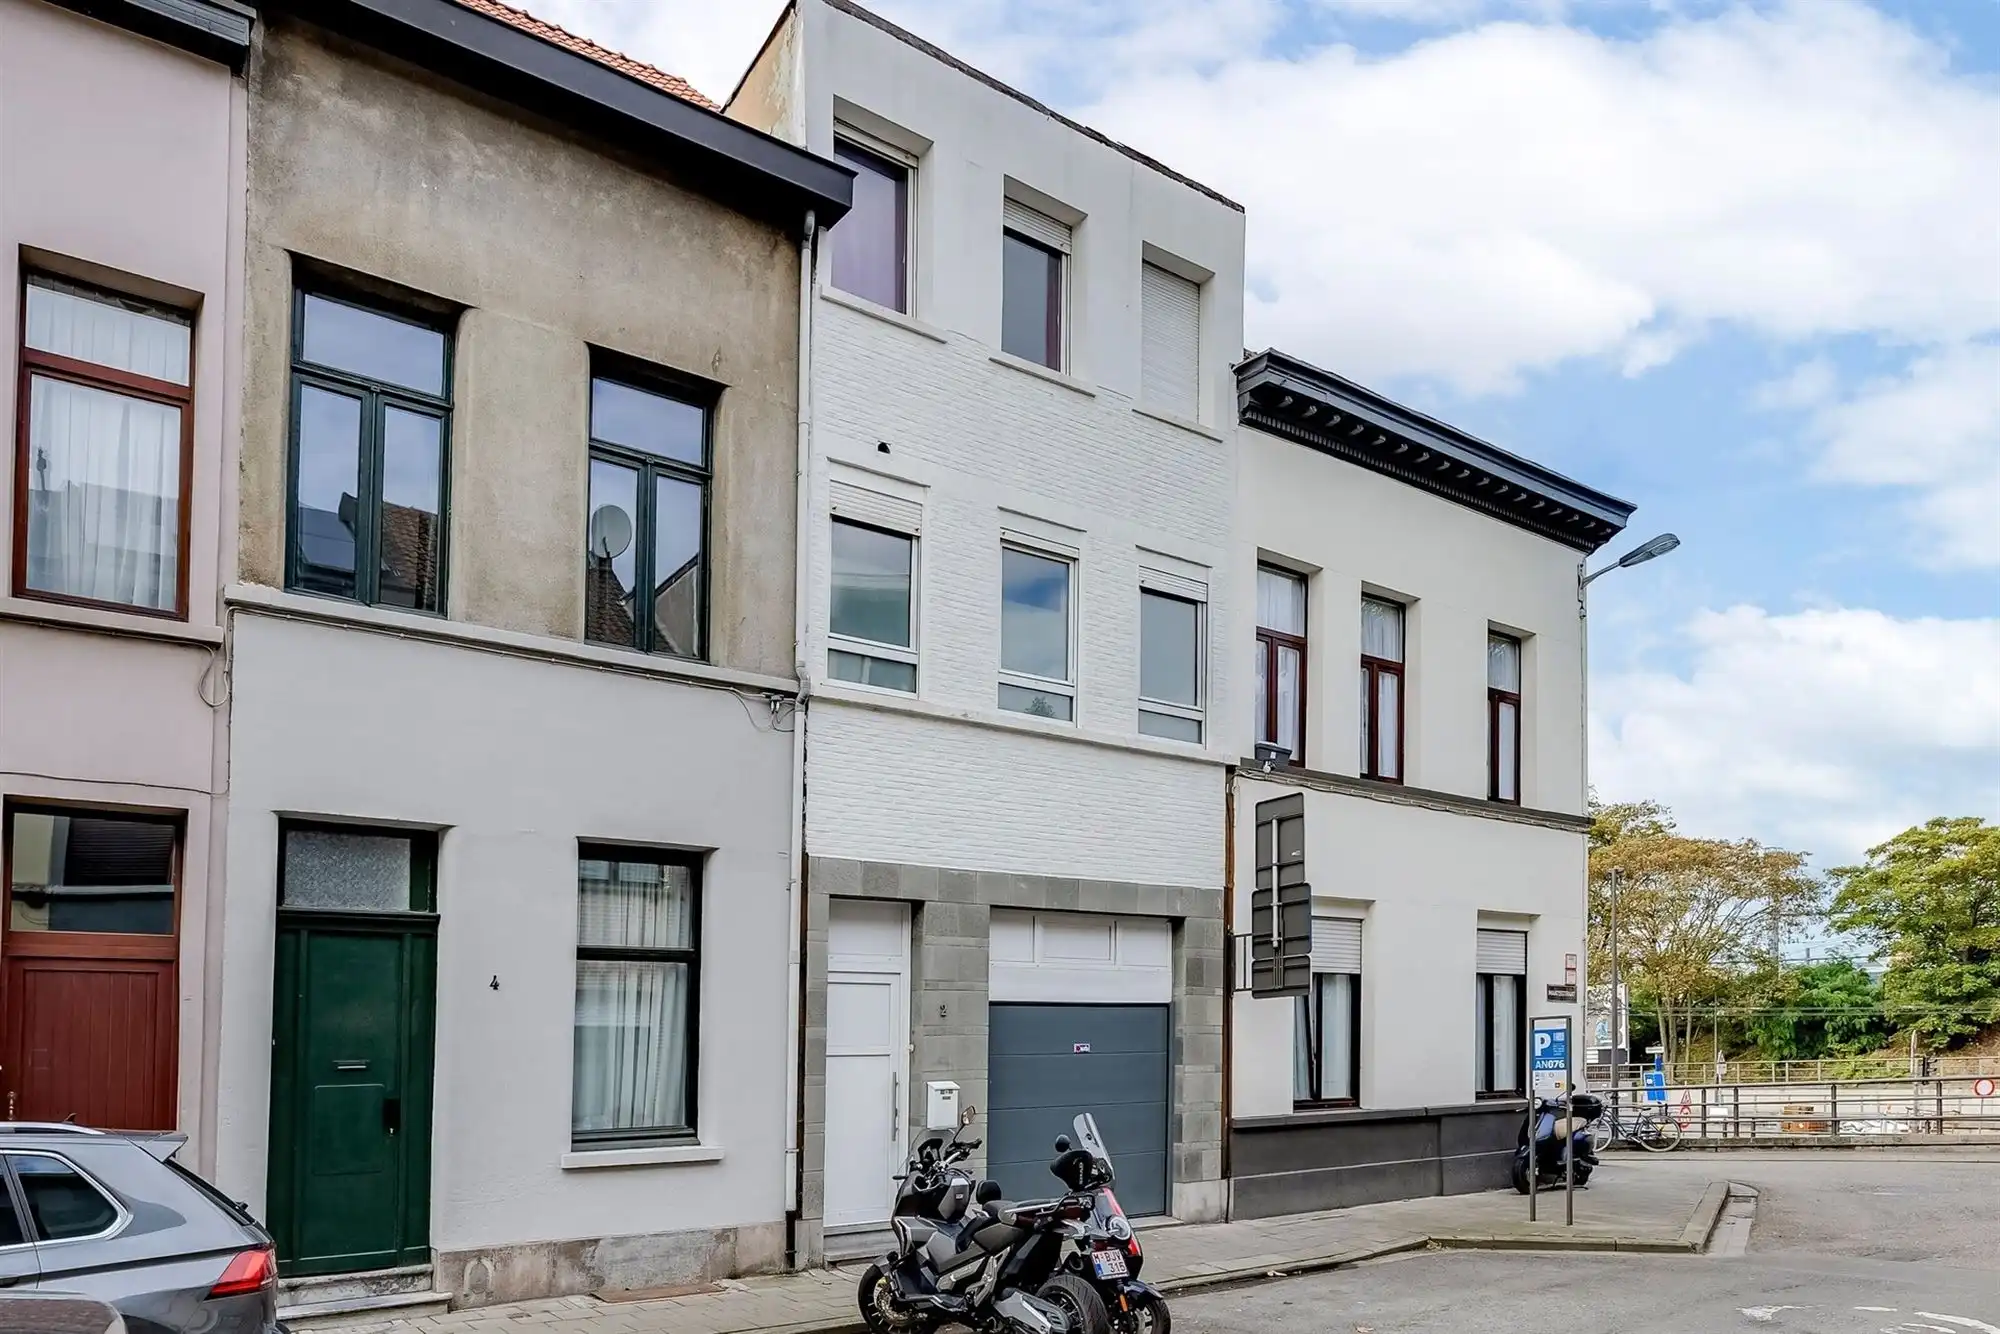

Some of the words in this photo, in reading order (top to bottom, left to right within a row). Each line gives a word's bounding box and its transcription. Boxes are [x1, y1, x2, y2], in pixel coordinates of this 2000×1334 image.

[489, 974, 500, 991] 4
[939, 1004, 947, 1018] 2
[1535, 1032, 1551, 1057] P
[1535, 1060, 1565, 1069] AN076
